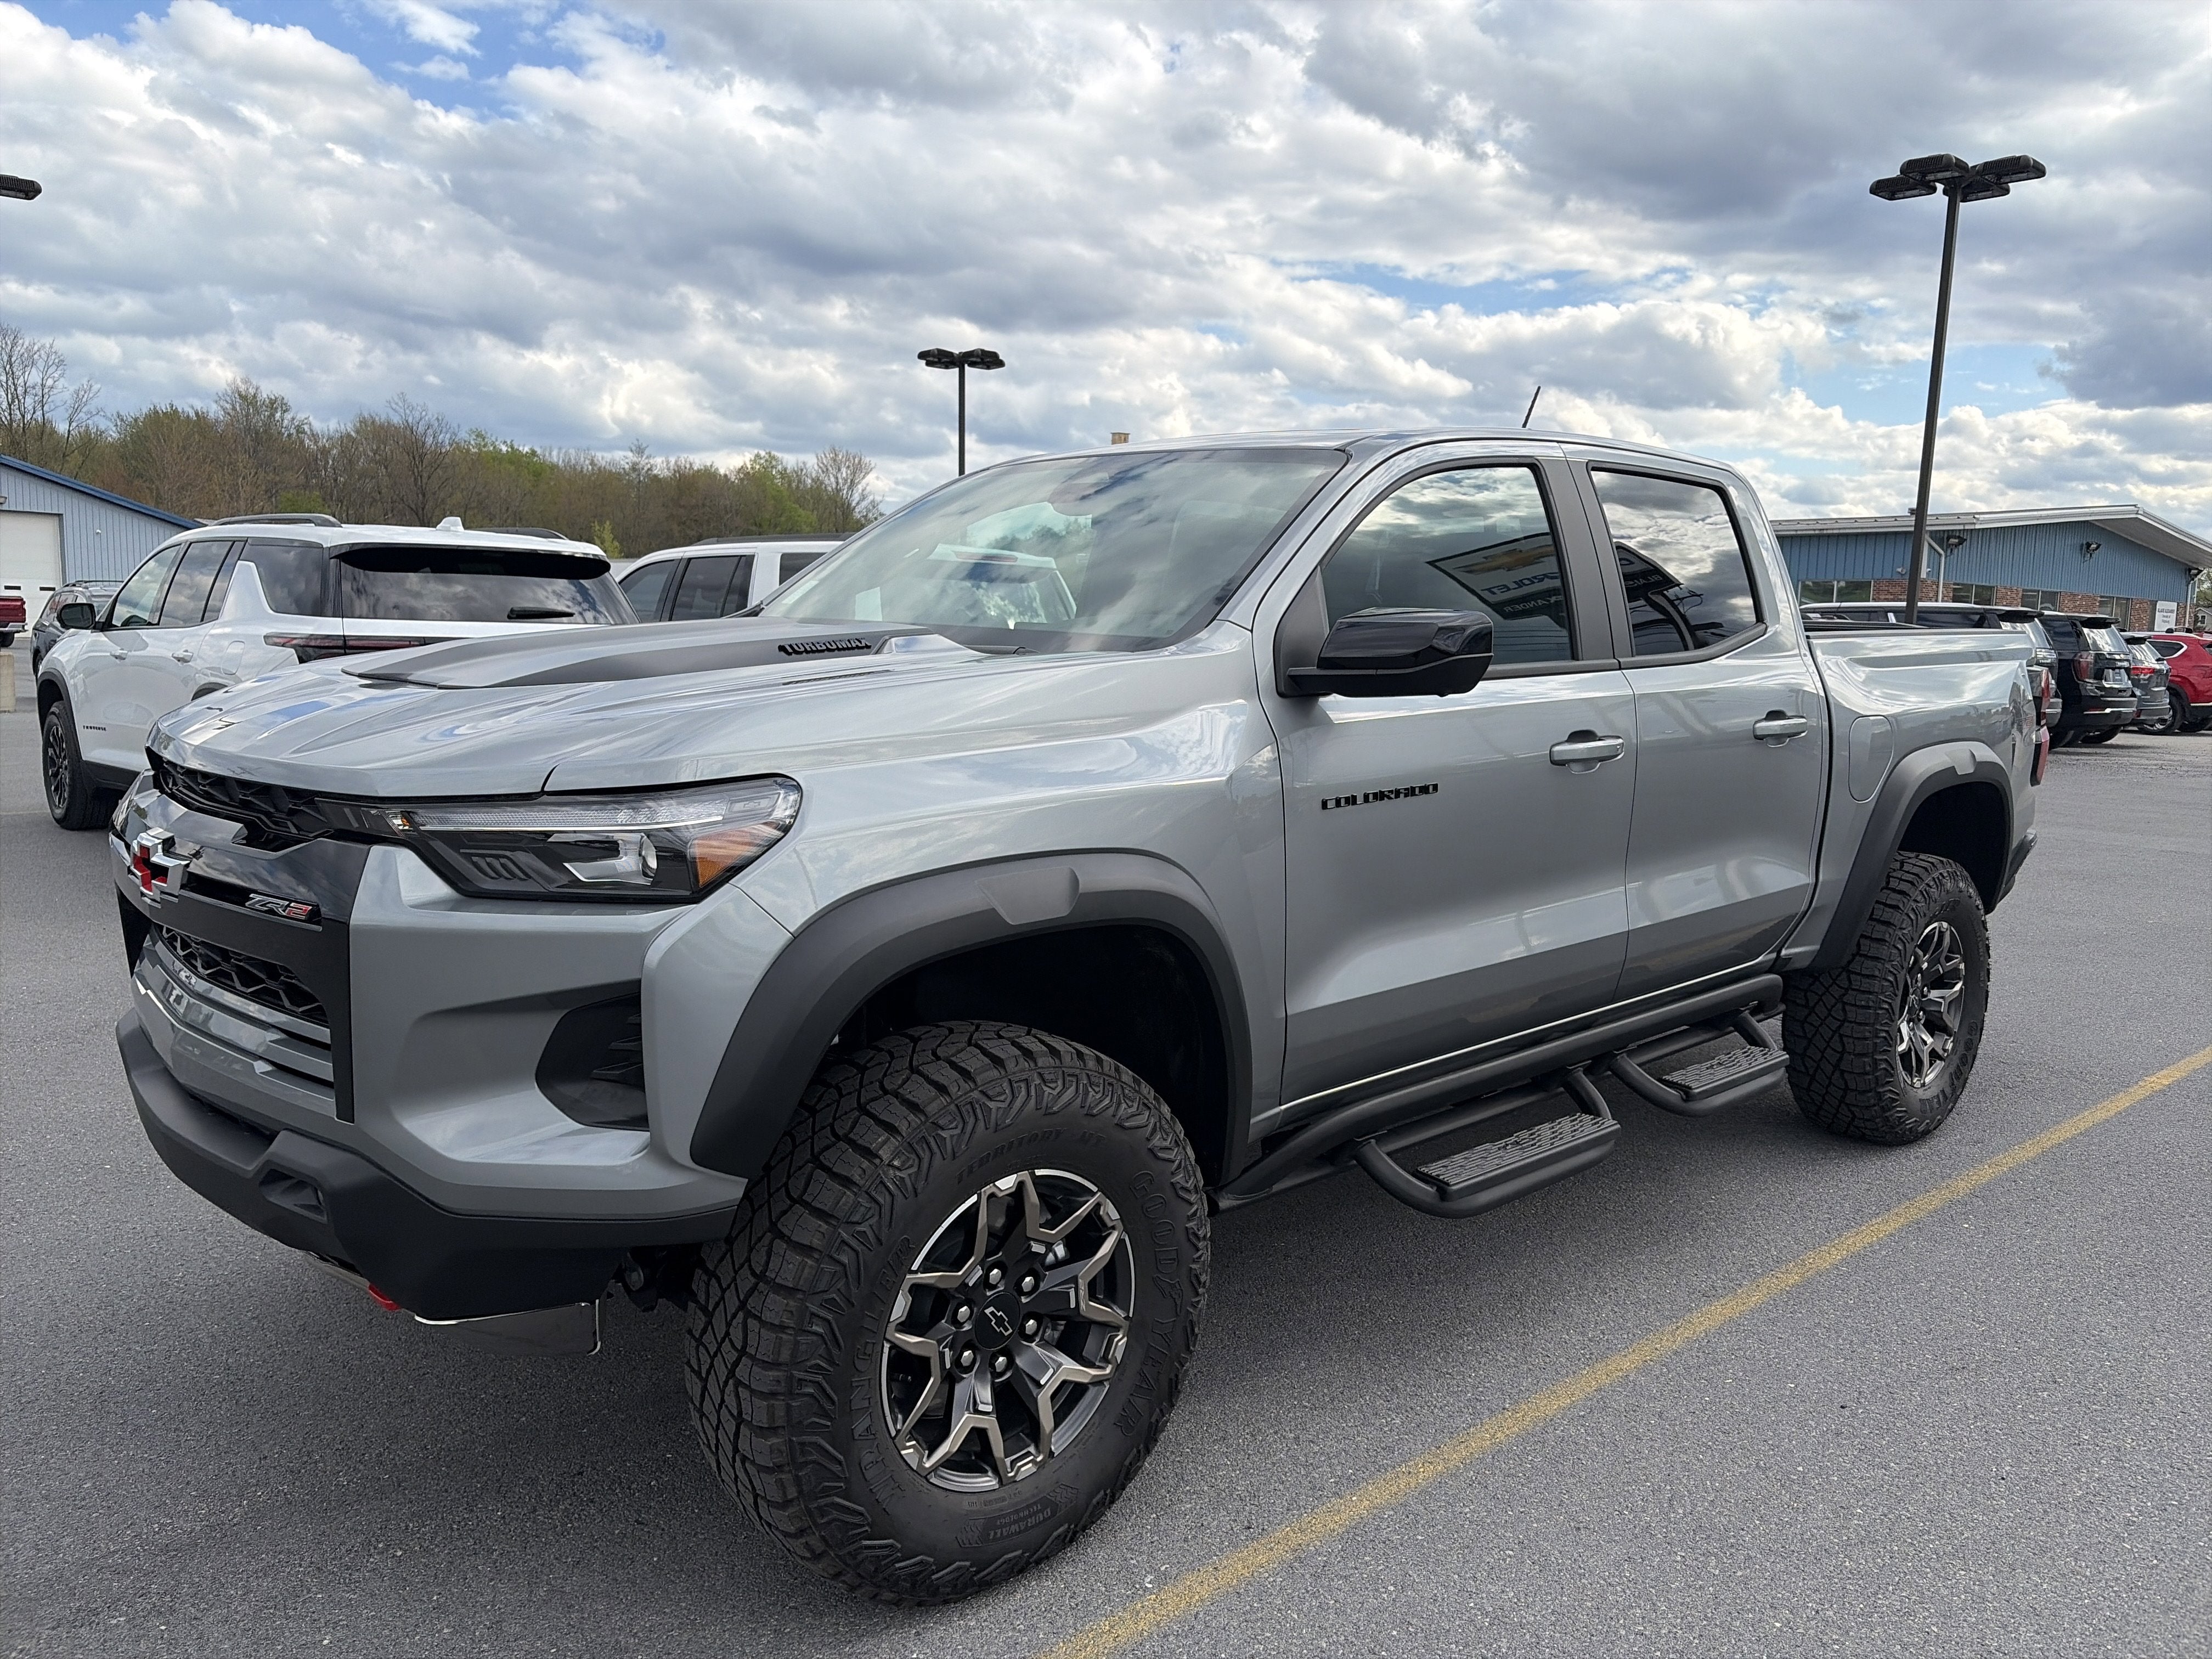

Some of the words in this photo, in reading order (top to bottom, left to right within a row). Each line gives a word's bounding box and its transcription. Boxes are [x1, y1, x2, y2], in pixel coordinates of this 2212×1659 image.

[778, 637, 872, 656] TURBOMAX
[1321, 782, 1439, 810] COLORADO
[245, 893, 313, 921] ZR2
[1114, 1170, 1183, 1437] GOODYEAR
[849, 1235, 916, 1511] WRANGLER
[989, 1508, 1052, 1539] DURAWALL
